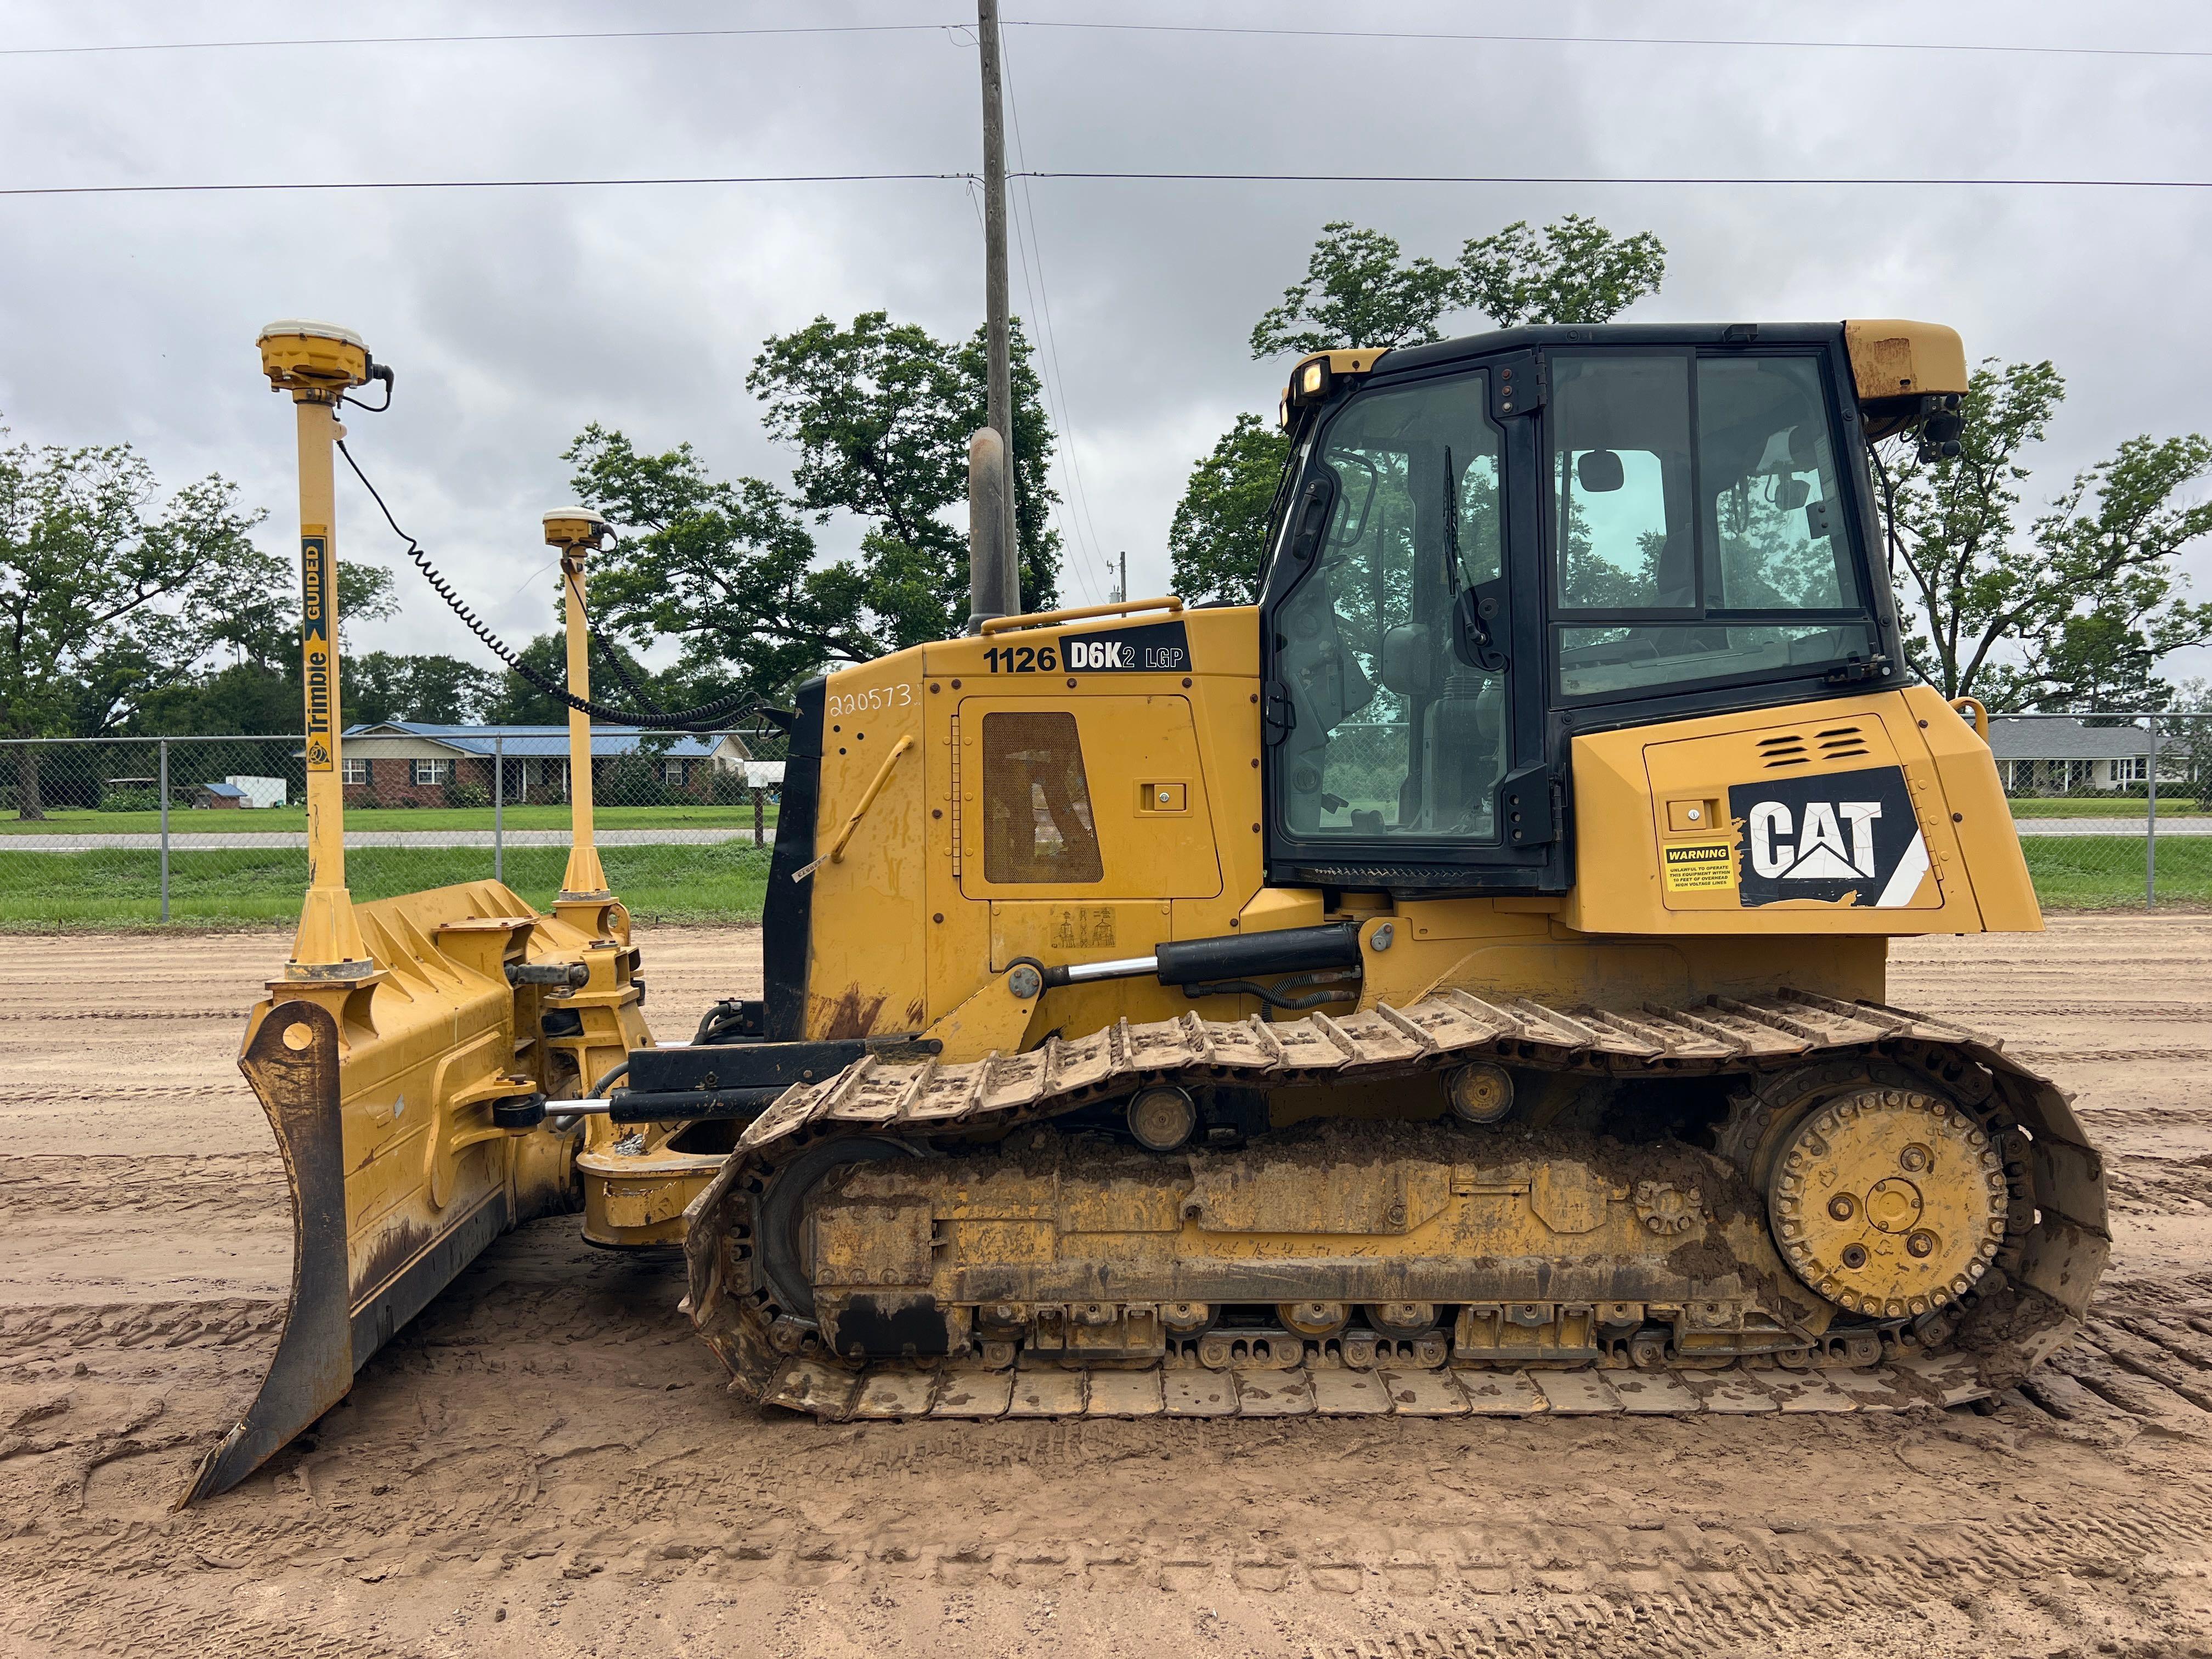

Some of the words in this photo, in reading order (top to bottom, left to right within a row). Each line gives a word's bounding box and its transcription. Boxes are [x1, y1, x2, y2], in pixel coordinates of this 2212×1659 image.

[306, 546, 320, 620] GUIDED
[983, 647, 1057, 673] 1126
[1146, 648, 1183, 668] LGP
[307, 652, 328, 737] Trimble
[829, 684, 911, 717] 220573
[1669, 849, 1726, 860] WARNING
[1750, 801, 1882, 878] CAT
